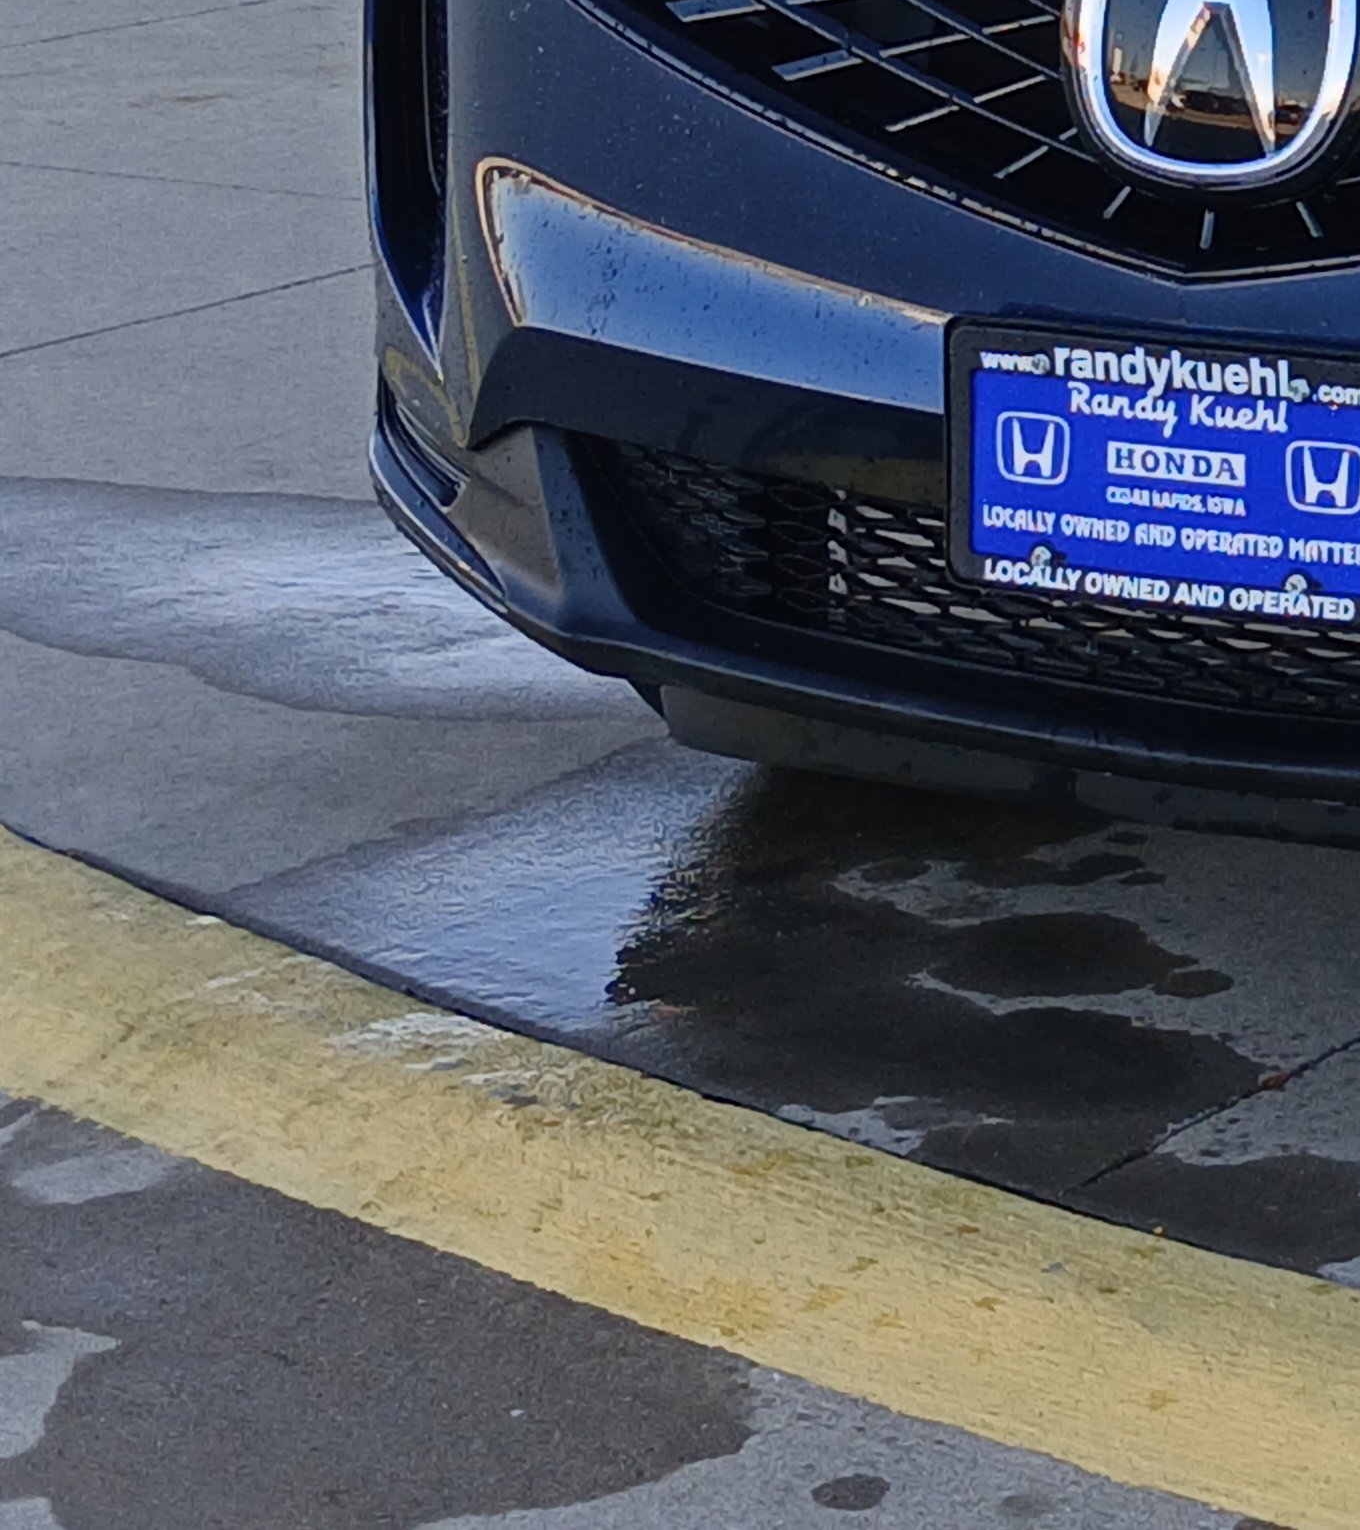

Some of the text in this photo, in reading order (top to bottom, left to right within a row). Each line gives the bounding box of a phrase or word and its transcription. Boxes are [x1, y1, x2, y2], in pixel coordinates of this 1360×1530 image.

[1067, 381, 1289, 438] Randy Kuehl
[1114, 447, 1239, 481] HONDA
[982, 504, 1056, 535] LOCALLY
[1060, 513, 1131, 542] OWNED
[1135, 523, 1177, 547] AND
[1180, 527, 1284, 558] OPERATED
[983, 558, 1356, 621] LOCALLY OWNED AND OPERATED
